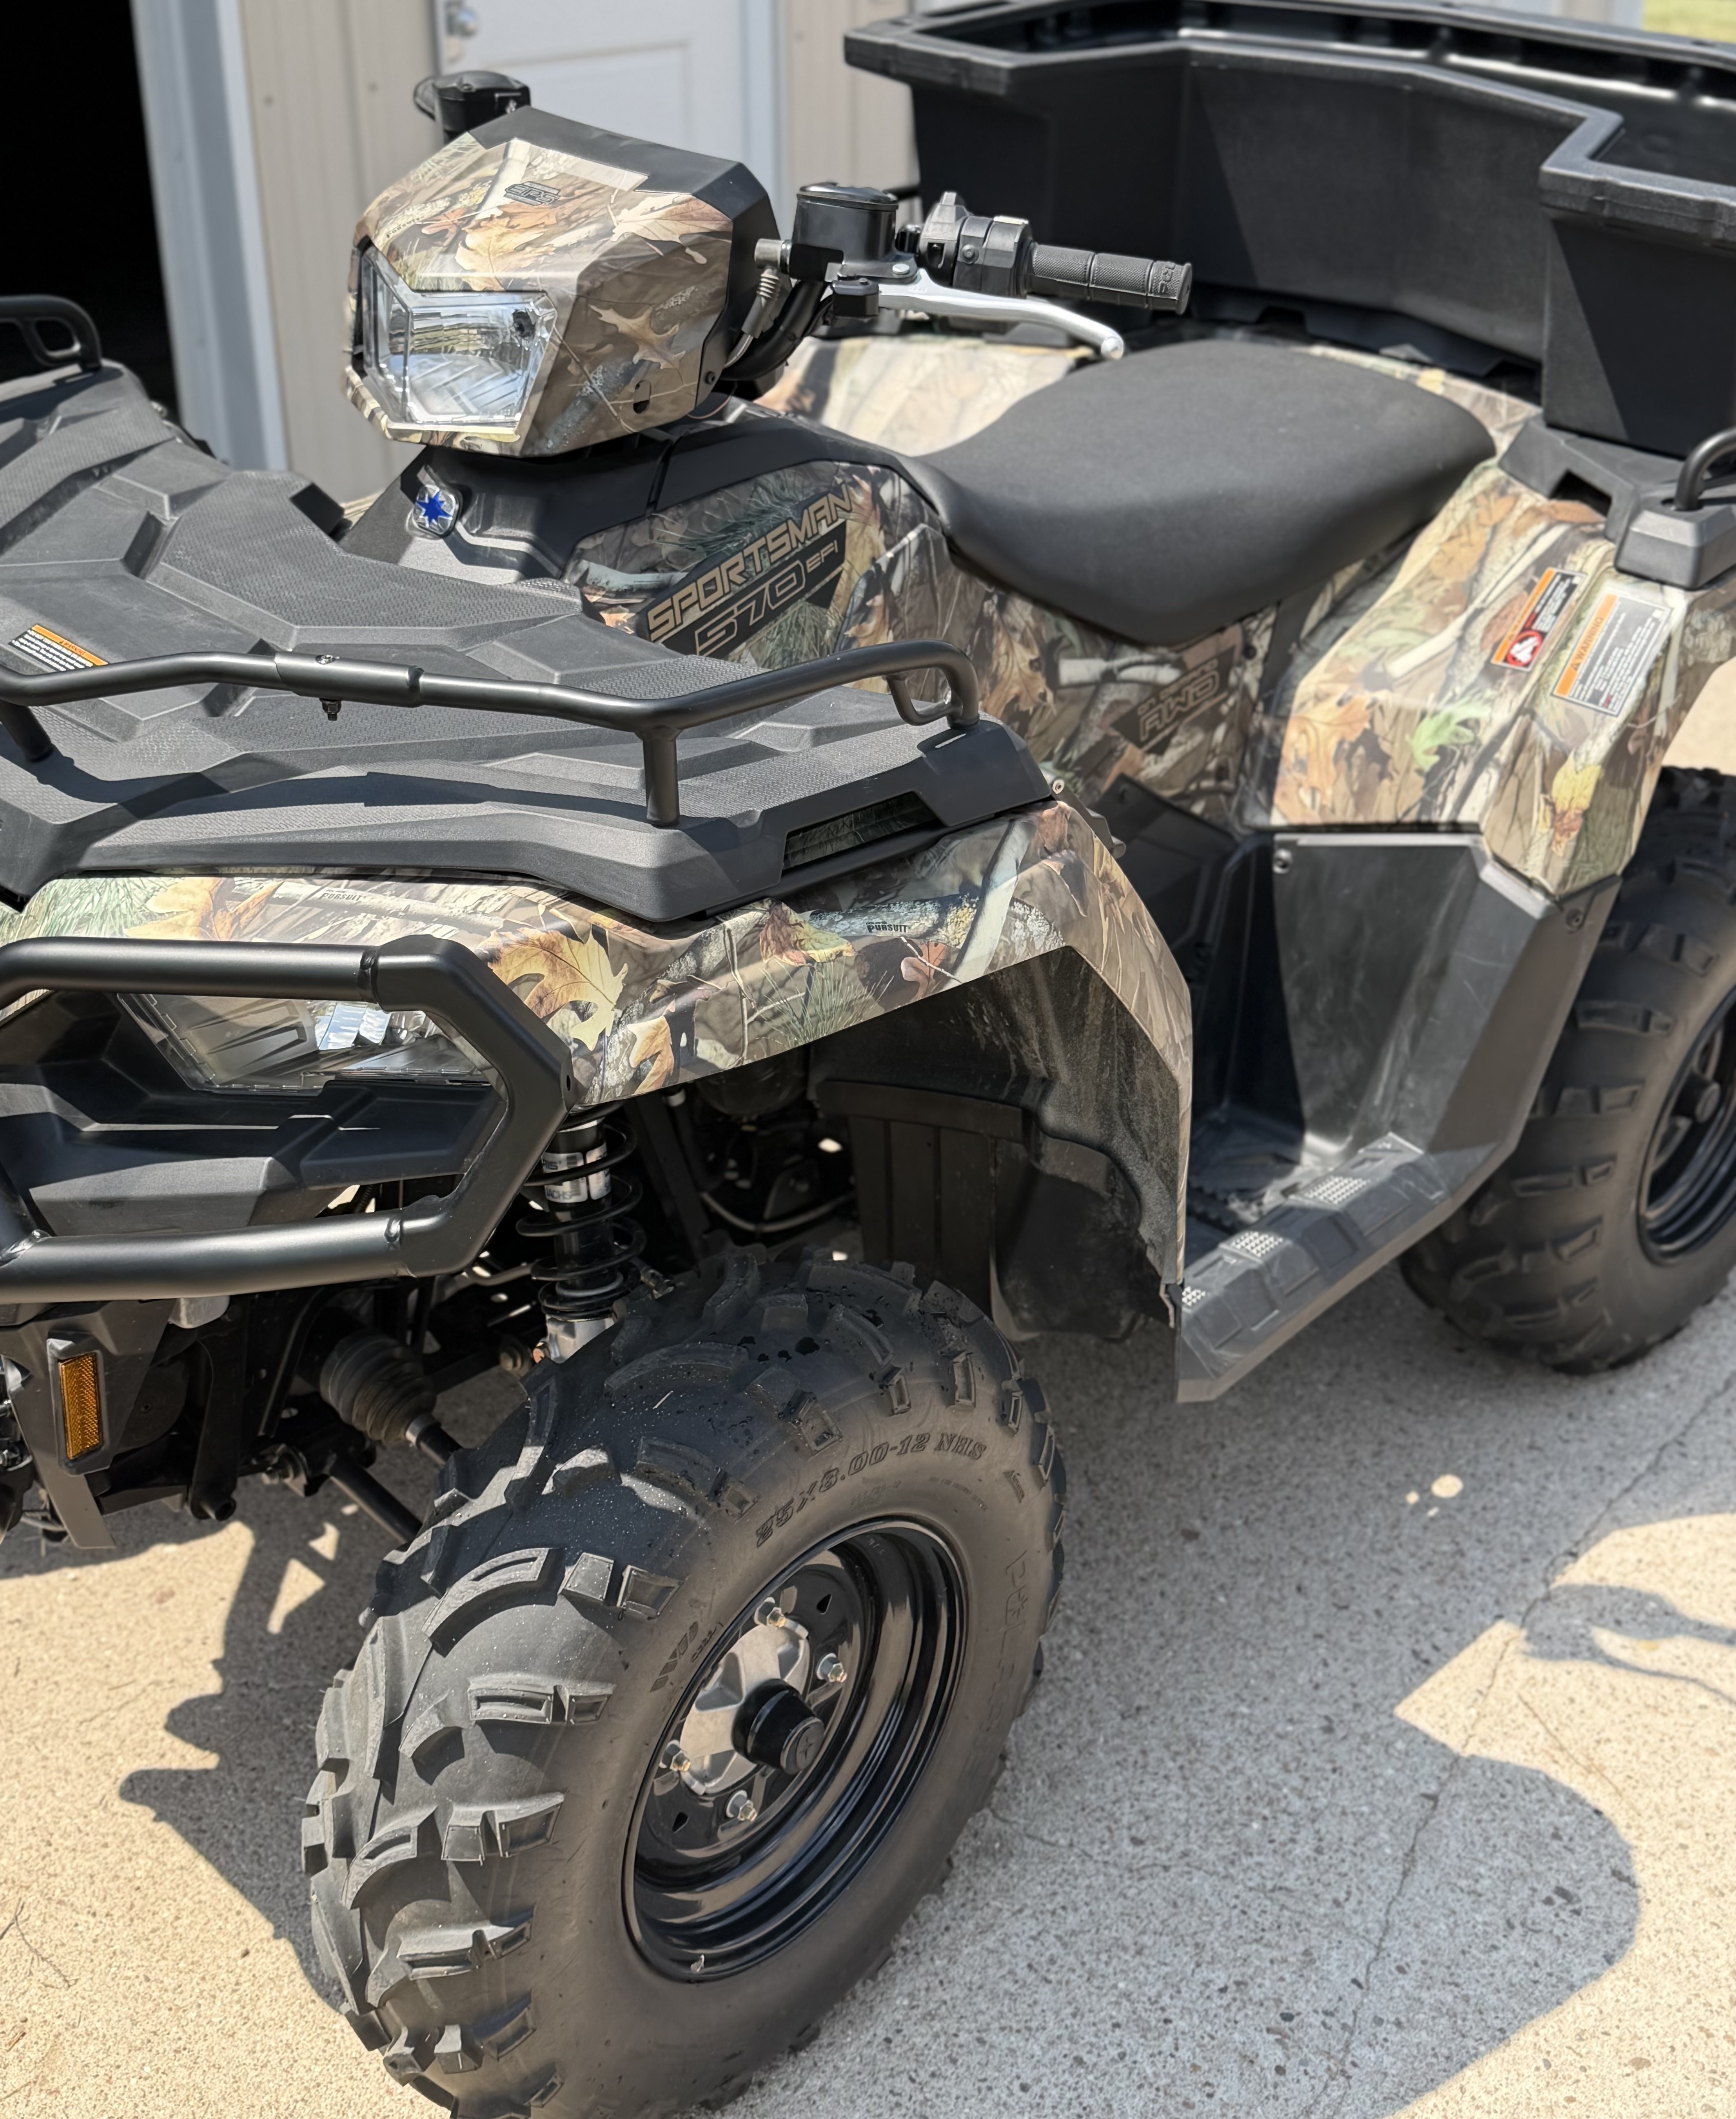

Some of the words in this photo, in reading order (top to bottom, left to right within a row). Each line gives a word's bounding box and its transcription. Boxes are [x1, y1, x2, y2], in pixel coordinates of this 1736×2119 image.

[506, 183, 561, 205] EPS
[647, 483, 852, 643] SPORTSMAN
[694, 559, 806, 658] 570
[805, 539, 838, 573] EFI
[1574, 616, 1605, 662] WARNING
[318, 892, 363, 901] PURSUIT
[867, 924, 909, 933] PURSUIT
[934, 1433, 987, 1460] NHS
